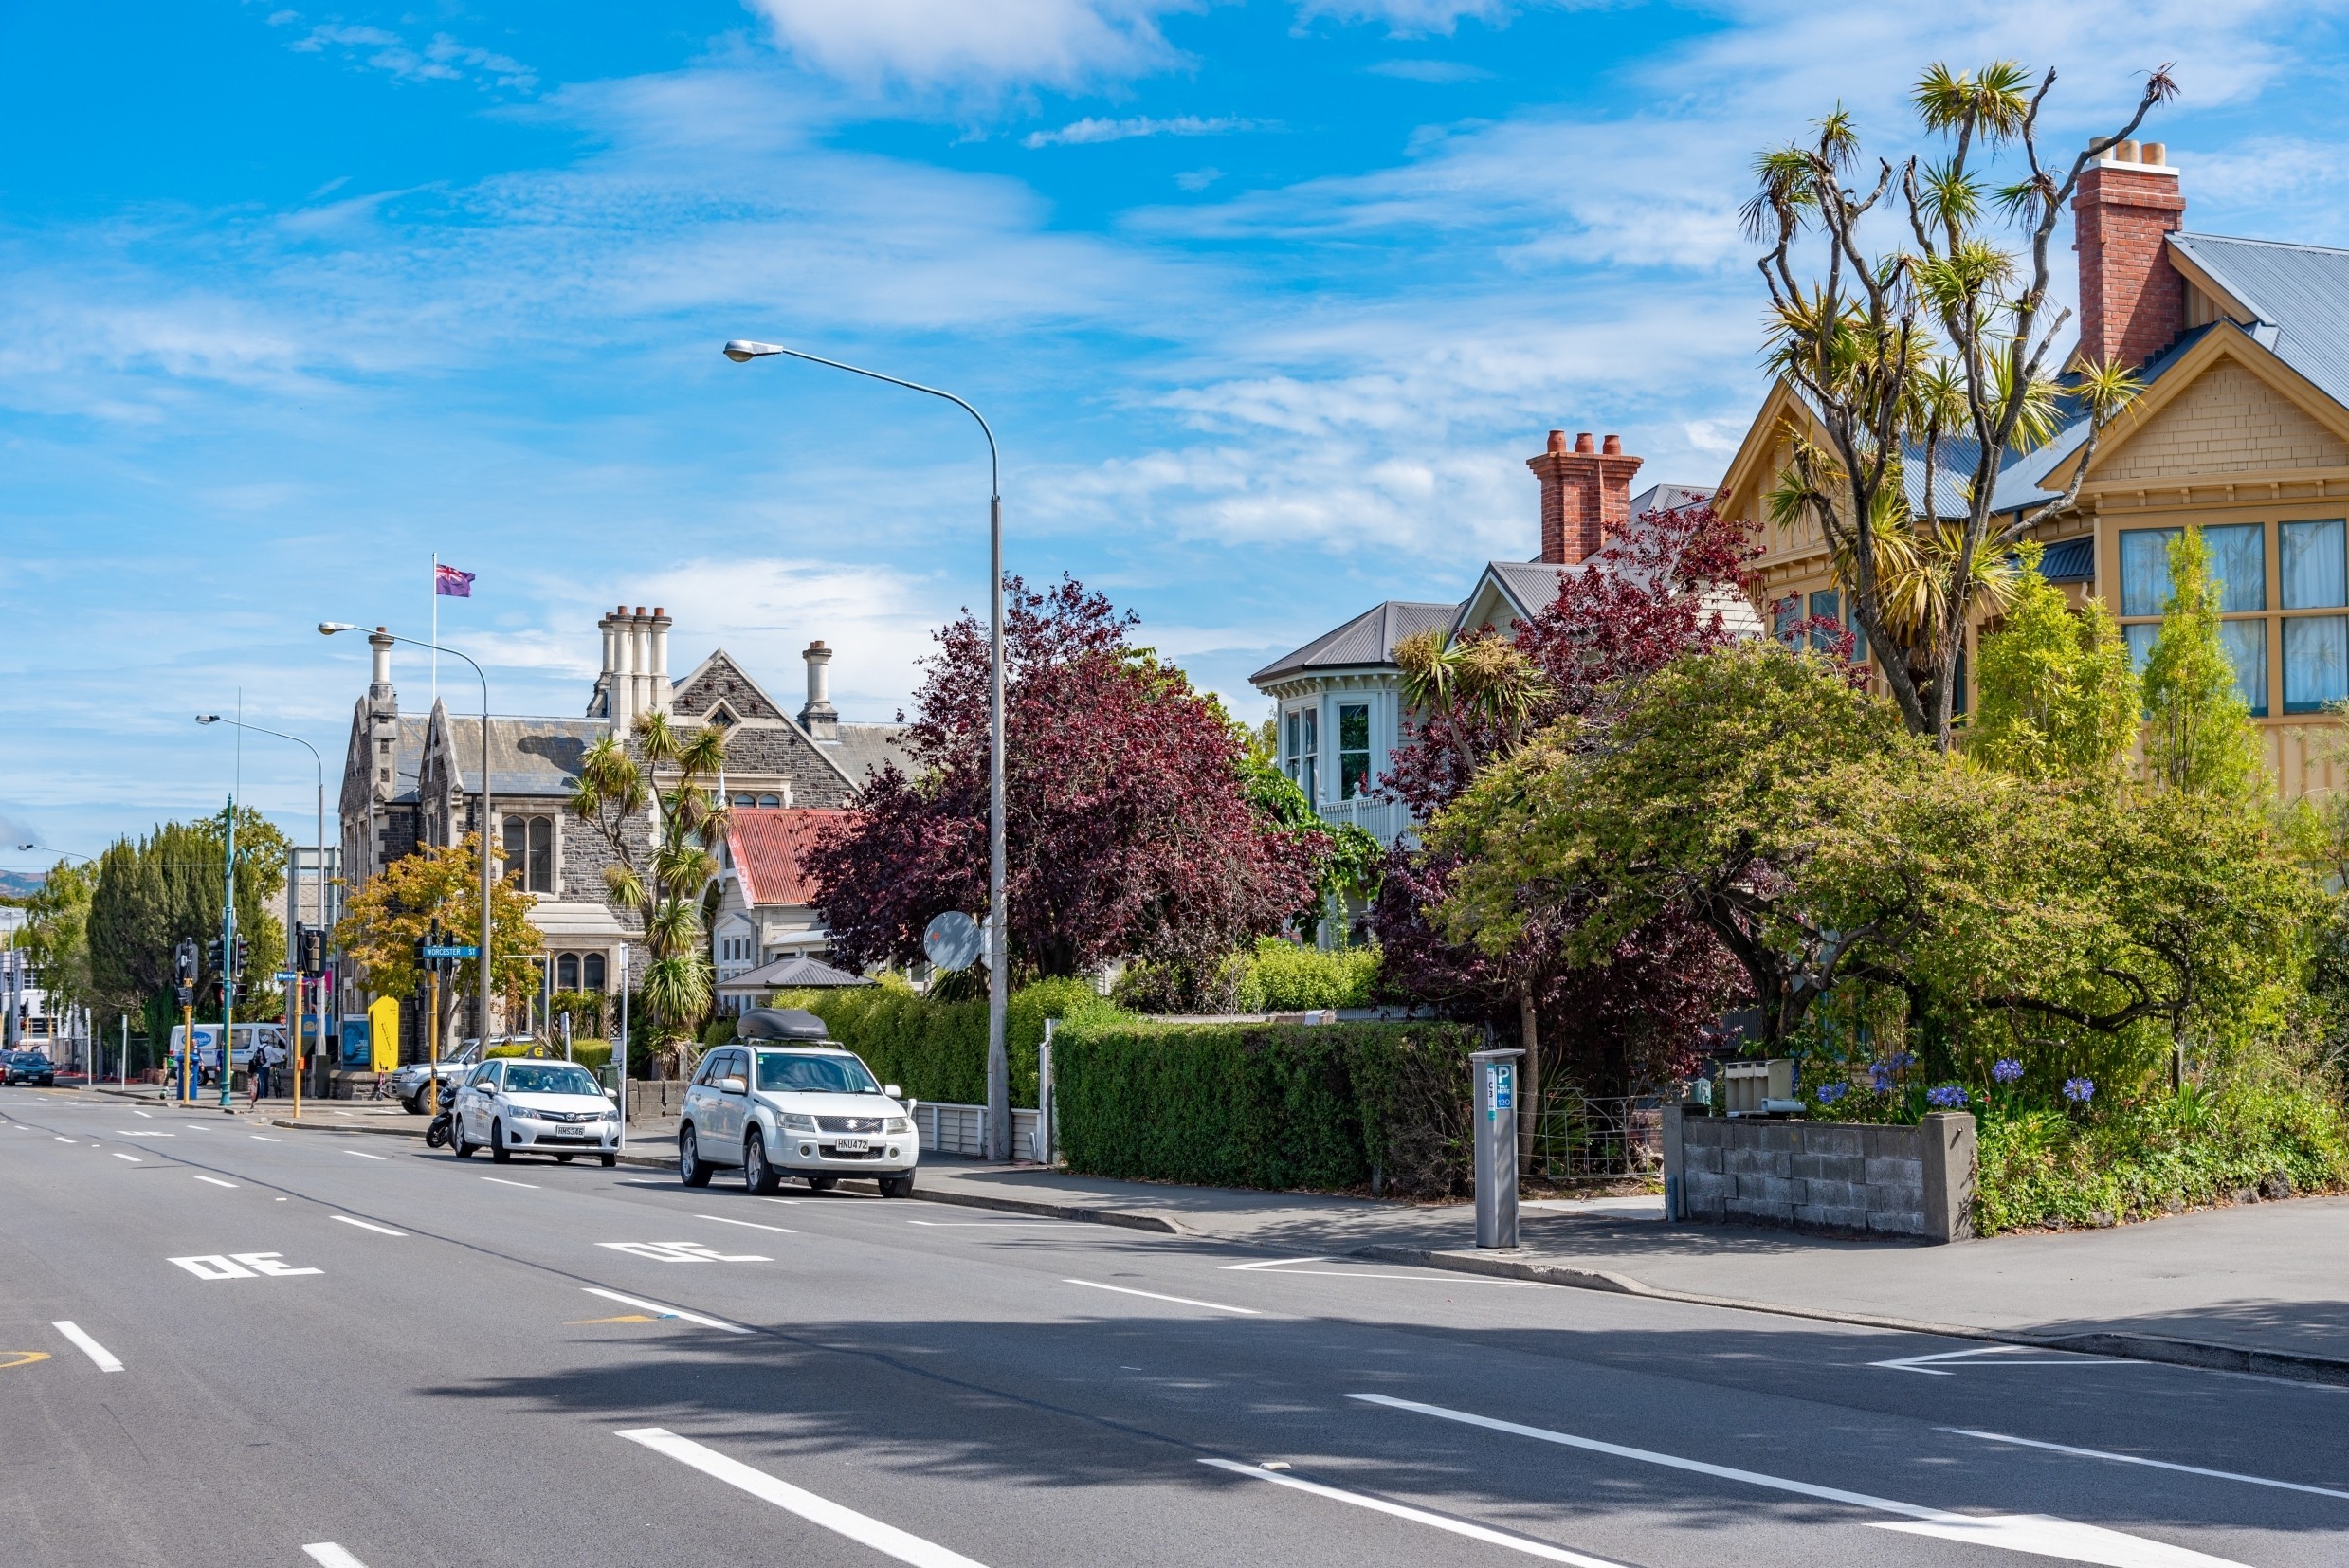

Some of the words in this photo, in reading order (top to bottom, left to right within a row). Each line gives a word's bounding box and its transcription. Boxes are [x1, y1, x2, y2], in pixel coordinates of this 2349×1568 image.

[534, 1047, 544, 1057] G
[1498, 1067, 1510, 1083] P
[838, 1140, 867, 1149] HNU472
